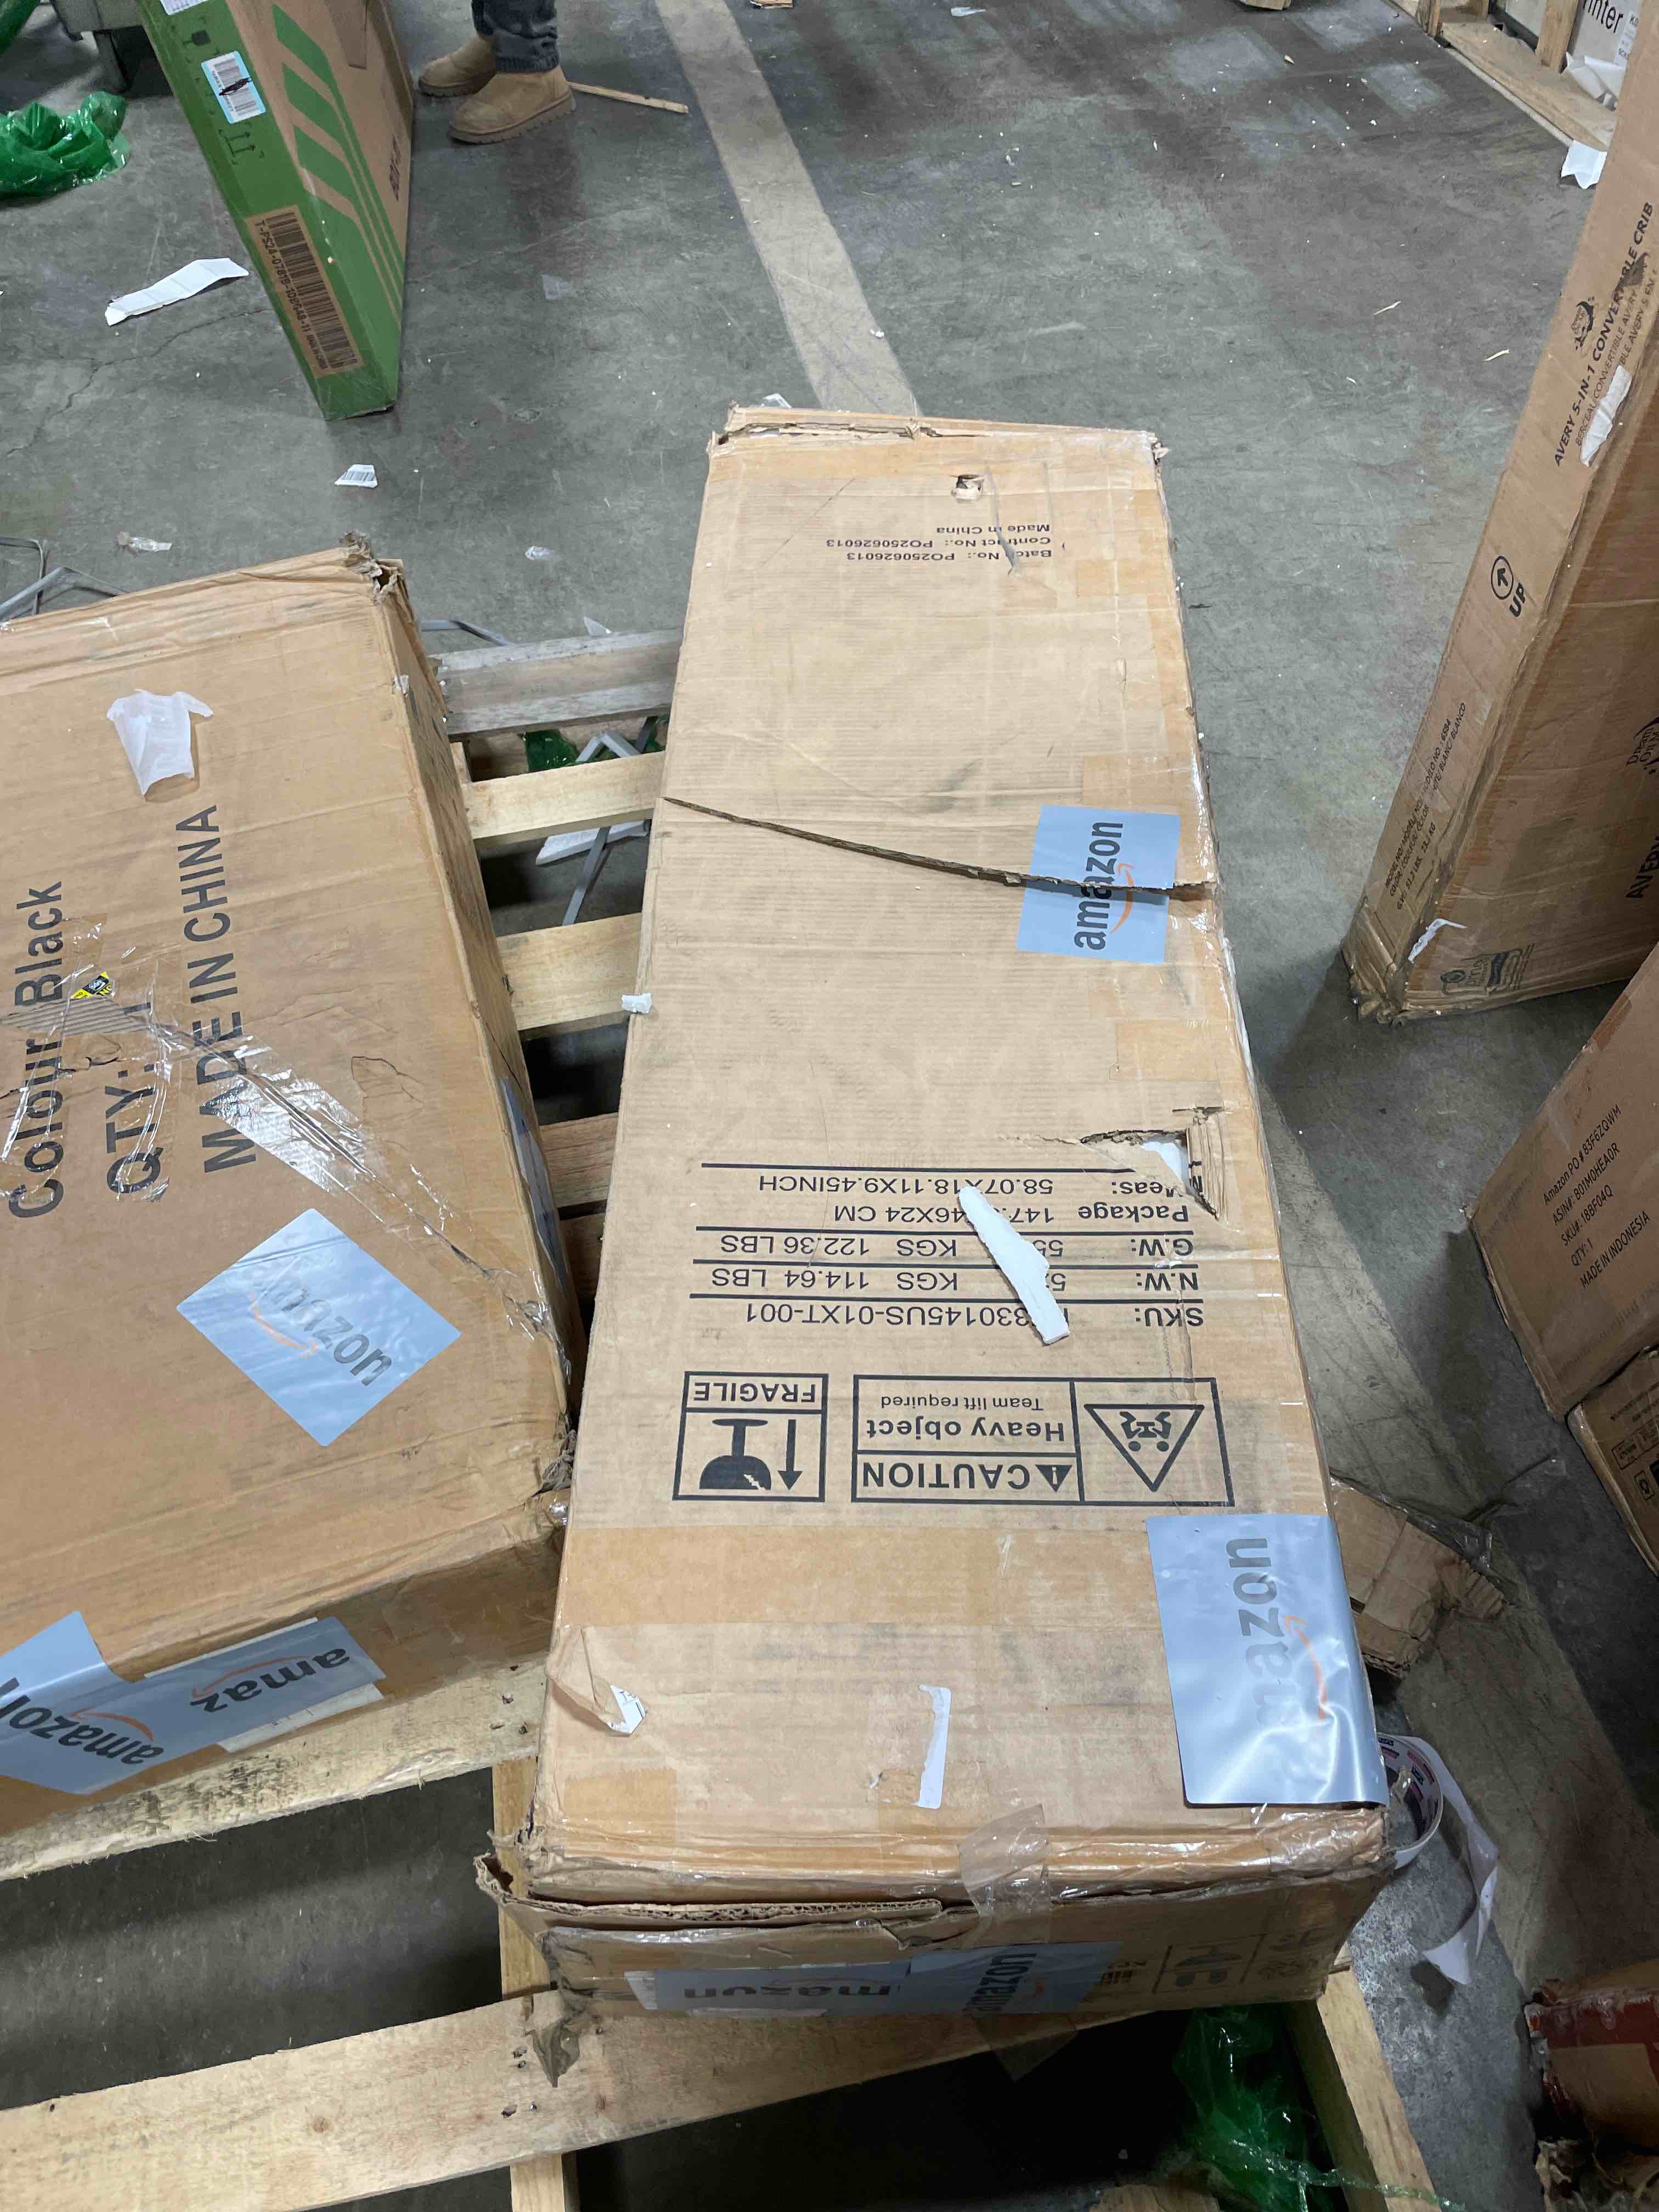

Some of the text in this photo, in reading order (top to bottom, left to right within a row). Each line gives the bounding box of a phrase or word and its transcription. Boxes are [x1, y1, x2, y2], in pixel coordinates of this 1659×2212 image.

[1555, 415, 1575, 466] AVERY
[1572, 364, 1595, 416] 5-IN-1
[1633, 202, 1653, 245] CRIB
[1593, 326, 1625, 399] CONVERTIBLE
[936, 526, 983, 534] China
[1007, 523, 1050, 533] Made
[826, 539, 933, 548] PO250626013
[944, 539, 977, 548] No.:
[847, 552, 955, 561] PO250626013
[967, 550, 1000, 560] No.:
[1509, 582, 1525, 617] UP
[1450, 702, 1466, 740] BLANCO
[1074, 822, 1123, 950] amazon
[176, 804, 257, 1173] MADE IN CHINA
[8, 881, 65, 1219] Colour Black
[105, 1063, 165, 1195] QTY:
[1544, 1170, 1570, 1206] Amazon
[1567, 1157, 1580, 1176] PO
[834, 1205, 877, 1222] CM
[1078, 1204, 1189, 1223] Package
[720, 1234, 775, 1254] LBS
[784, 1235, 870, 1255] 122.36
[896, 1238, 956, 1257] KGS
[1131, 1237, 1194, 1257] G.W:
[1579, 1210, 1651, 1289] MADE IN INDONESIA
[1571, 1243, 1589, 1267] QTY:
[712, 1268, 767, 1288] LBS
[785, 1269, 870, 1290] 114.64
[897, 1271, 958, 1291] KGS
[1136, 1272, 1199, 1291] N.W:
[747, 1303, 1204, 1328] SKU: 330145US-01XT-001
[693, 1381, 817, 1403] FRAGILE
[881, 1395, 1045, 1411] Team lift required
[866, 1415, 1065, 1442] Heavy object
[863, 1462, 1030, 1489] CAUTION
[190, 1647, 350, 1713] amaz
